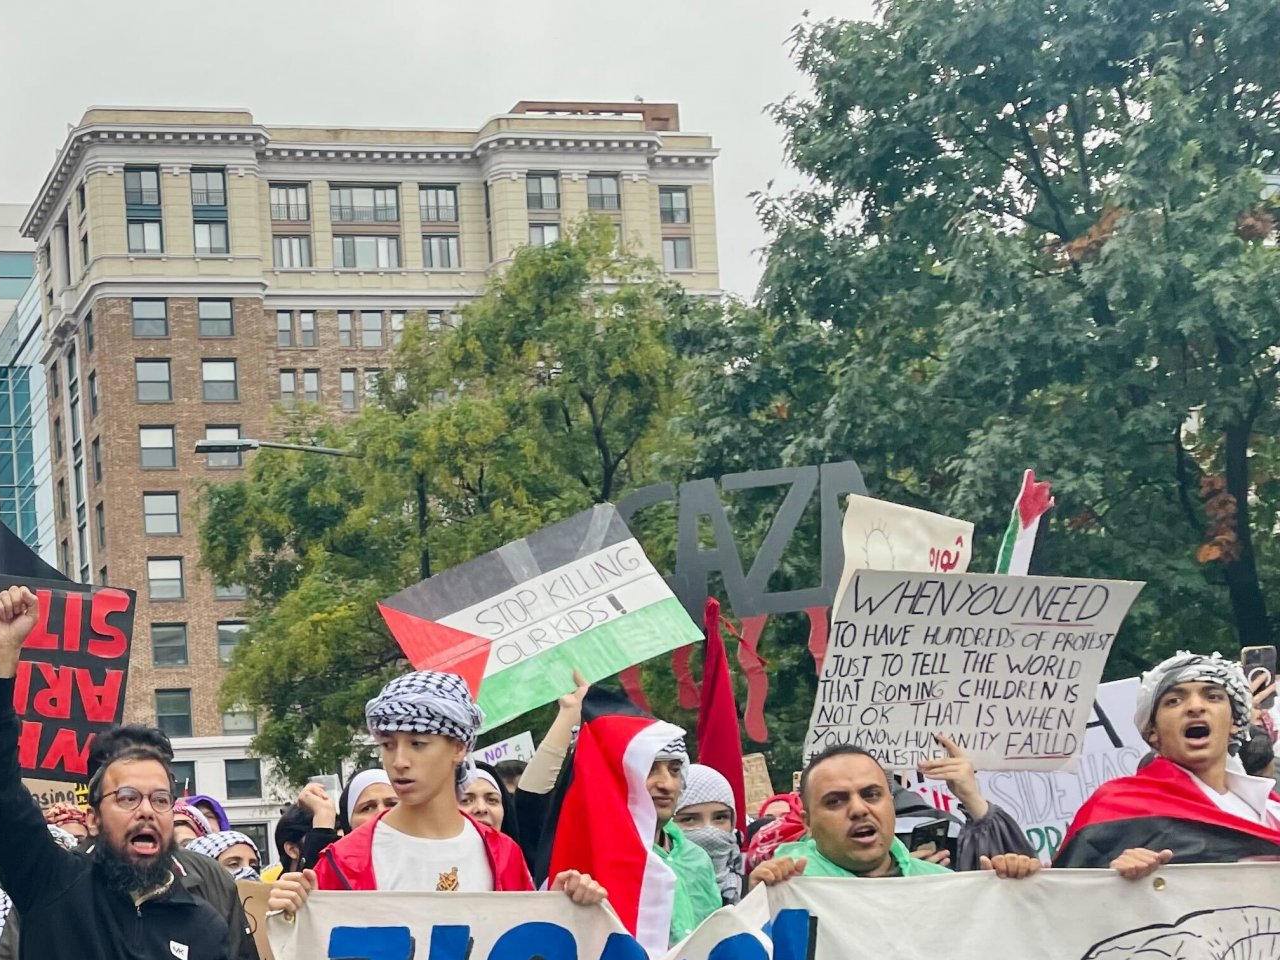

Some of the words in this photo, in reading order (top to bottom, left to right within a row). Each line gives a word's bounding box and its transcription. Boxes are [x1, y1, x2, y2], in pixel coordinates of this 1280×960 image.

[475, 589, 538, 635] STOP
[541, 546, 641, 608] KILLING
[854, 575, 962, 616] WHEN
[956, 582, 1024, 616] YOU
[1020, 584, 1109, 623] NEED
[496, 628, 556, 665] OUR
[833, 620, 857, 648] TO
[862, 624, 915, 647] HAVE
[1021, 630, 1051, 651] OF
[1052, 632, 1116, 652] PROTEST
[824, 654, 873, 678] JUST
[881, 653, 904, 677] TO
[911, 652, 950, 677] TELL
[962, 650, 998, 674] THE
[1006, 653, 1082, 680] WORLD
[820, 679, 864, 703] THAT
[871, 680, 948, 703] BOMING
[958, 678, 1058, 701] CHILDREN
[1064, 683, 1080, 703] IS
[817, 703, 857, 725] NOT
[860, 705, 894, 726] OK
[910, 700, 970, 728] THAT
[975, 703, 998, 728] IS
[1006, 706, 1075, 731] WHEN
[484, 742, 509, 763] NOT
[812, 727, 851, 746] YOU
[854, 728, 901, 747] KNOW
[989, 771, 1073, 825] SIDE
